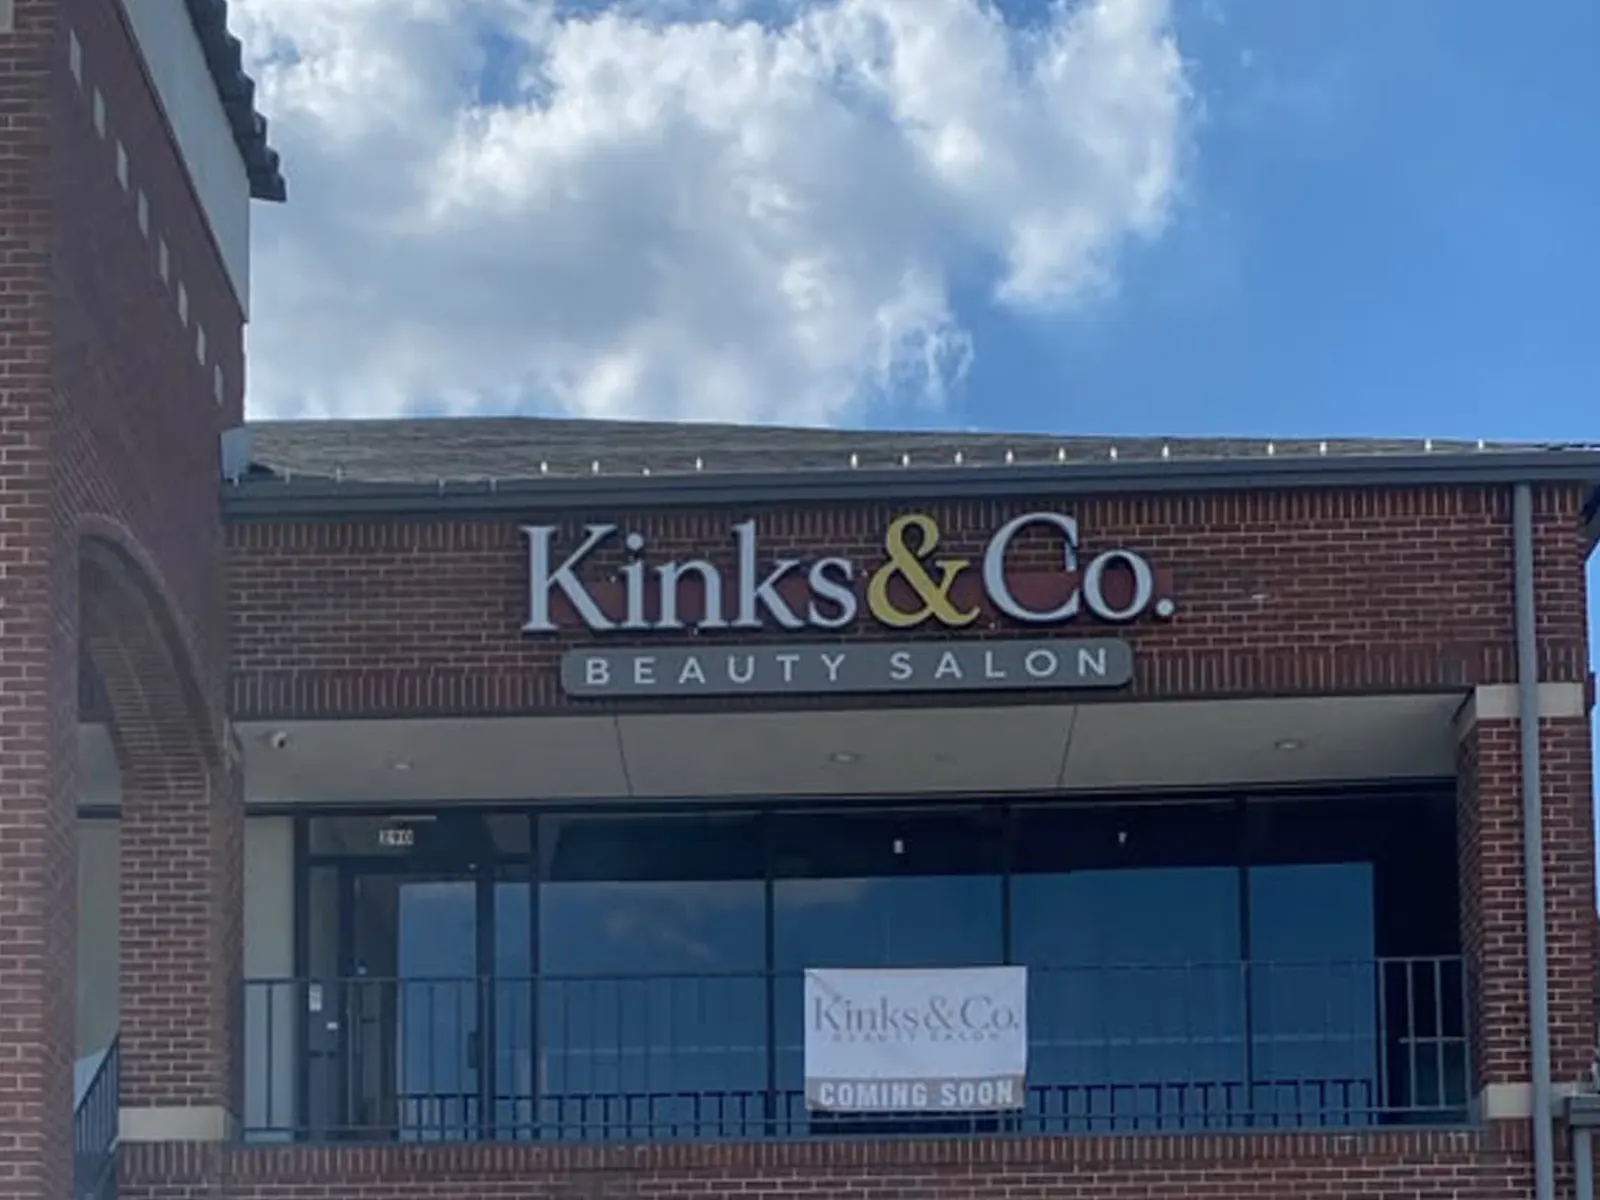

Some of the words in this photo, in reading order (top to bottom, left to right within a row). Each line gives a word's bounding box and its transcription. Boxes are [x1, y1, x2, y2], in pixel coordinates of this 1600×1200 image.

[521, 511, 1176, 634] Kinks&Co.
[585, 653, 846, 686] BEAUTY
[889, 648, 1107, 681] SALON
[814, 995, 1020, 1032] Kinks&Co.
[819, 1081, 927, 1108] COMING
[940, 1079, 1014, 1106] SOON
